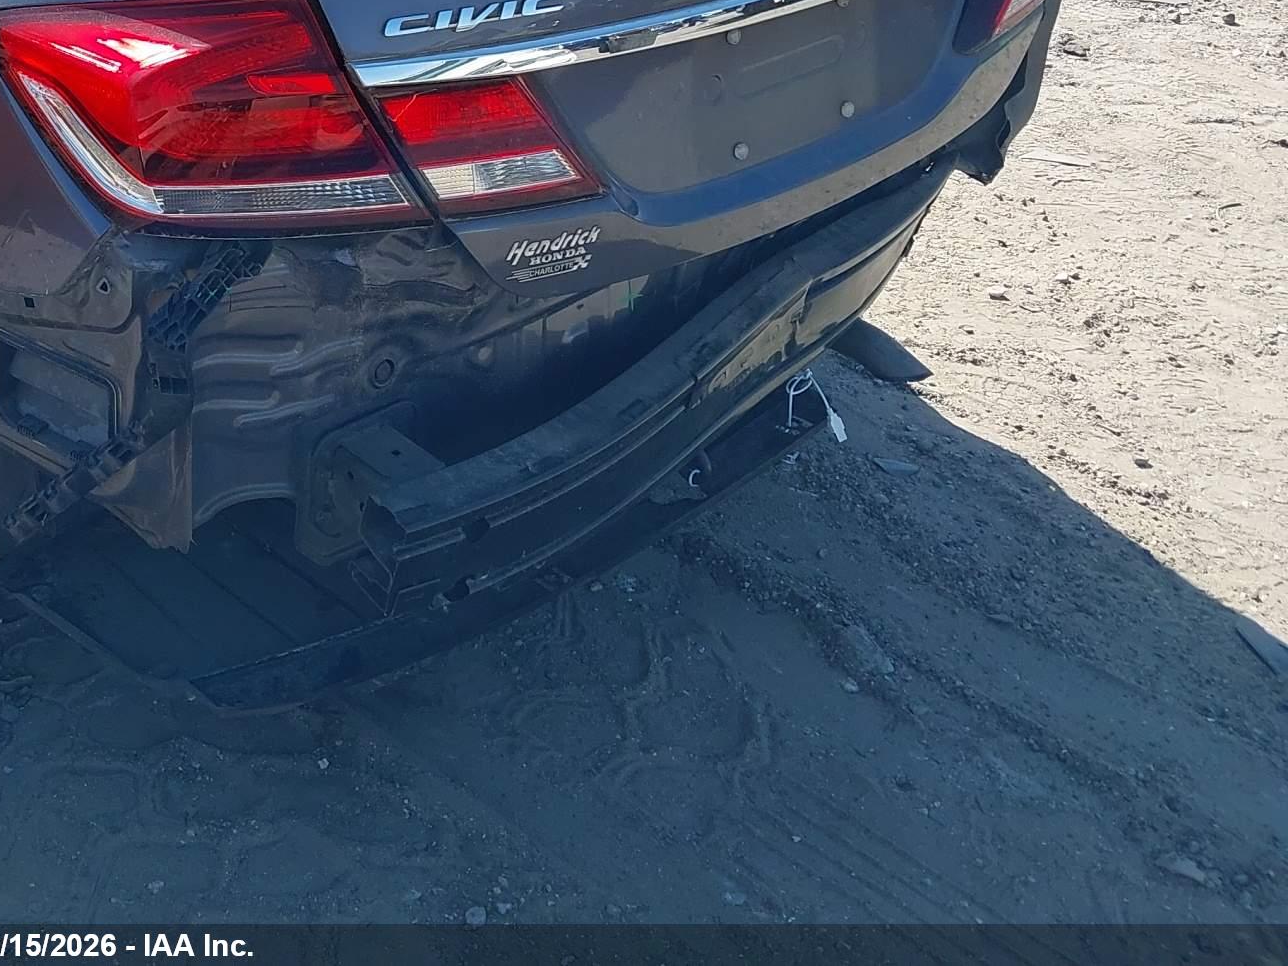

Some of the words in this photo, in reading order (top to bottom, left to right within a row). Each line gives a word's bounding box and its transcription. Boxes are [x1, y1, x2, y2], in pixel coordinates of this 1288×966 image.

[505, 225, 601, 266] Hendrick
[529, 246, 586, 266] HONDA
[529, 261, 574, 277] CHARLOTTE
